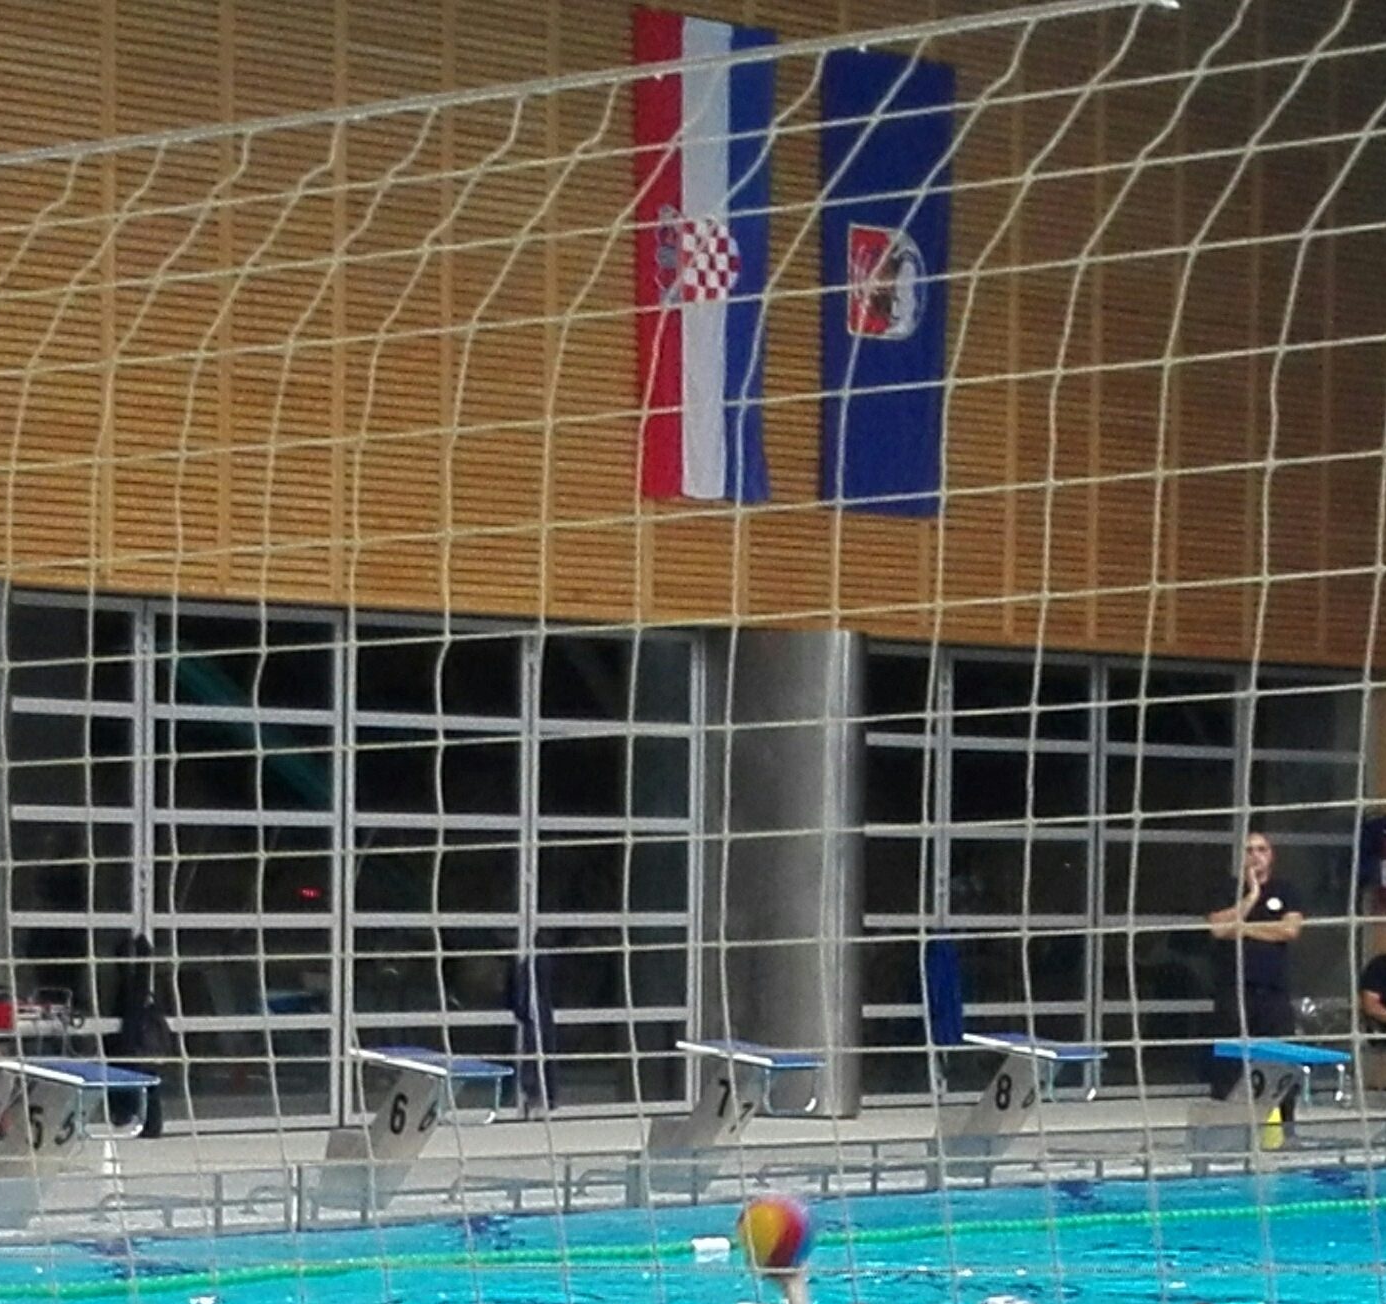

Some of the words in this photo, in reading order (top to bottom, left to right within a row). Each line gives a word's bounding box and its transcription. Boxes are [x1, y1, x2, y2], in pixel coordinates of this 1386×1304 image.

[717, 1079, 732, 1118] 7
[995, 1073, 1012, 1111] 8
[26, 1105, 44, 1151] 5
[390, 1092, 408, 1136] 6
[729, 1102, 753, 1134] 7
